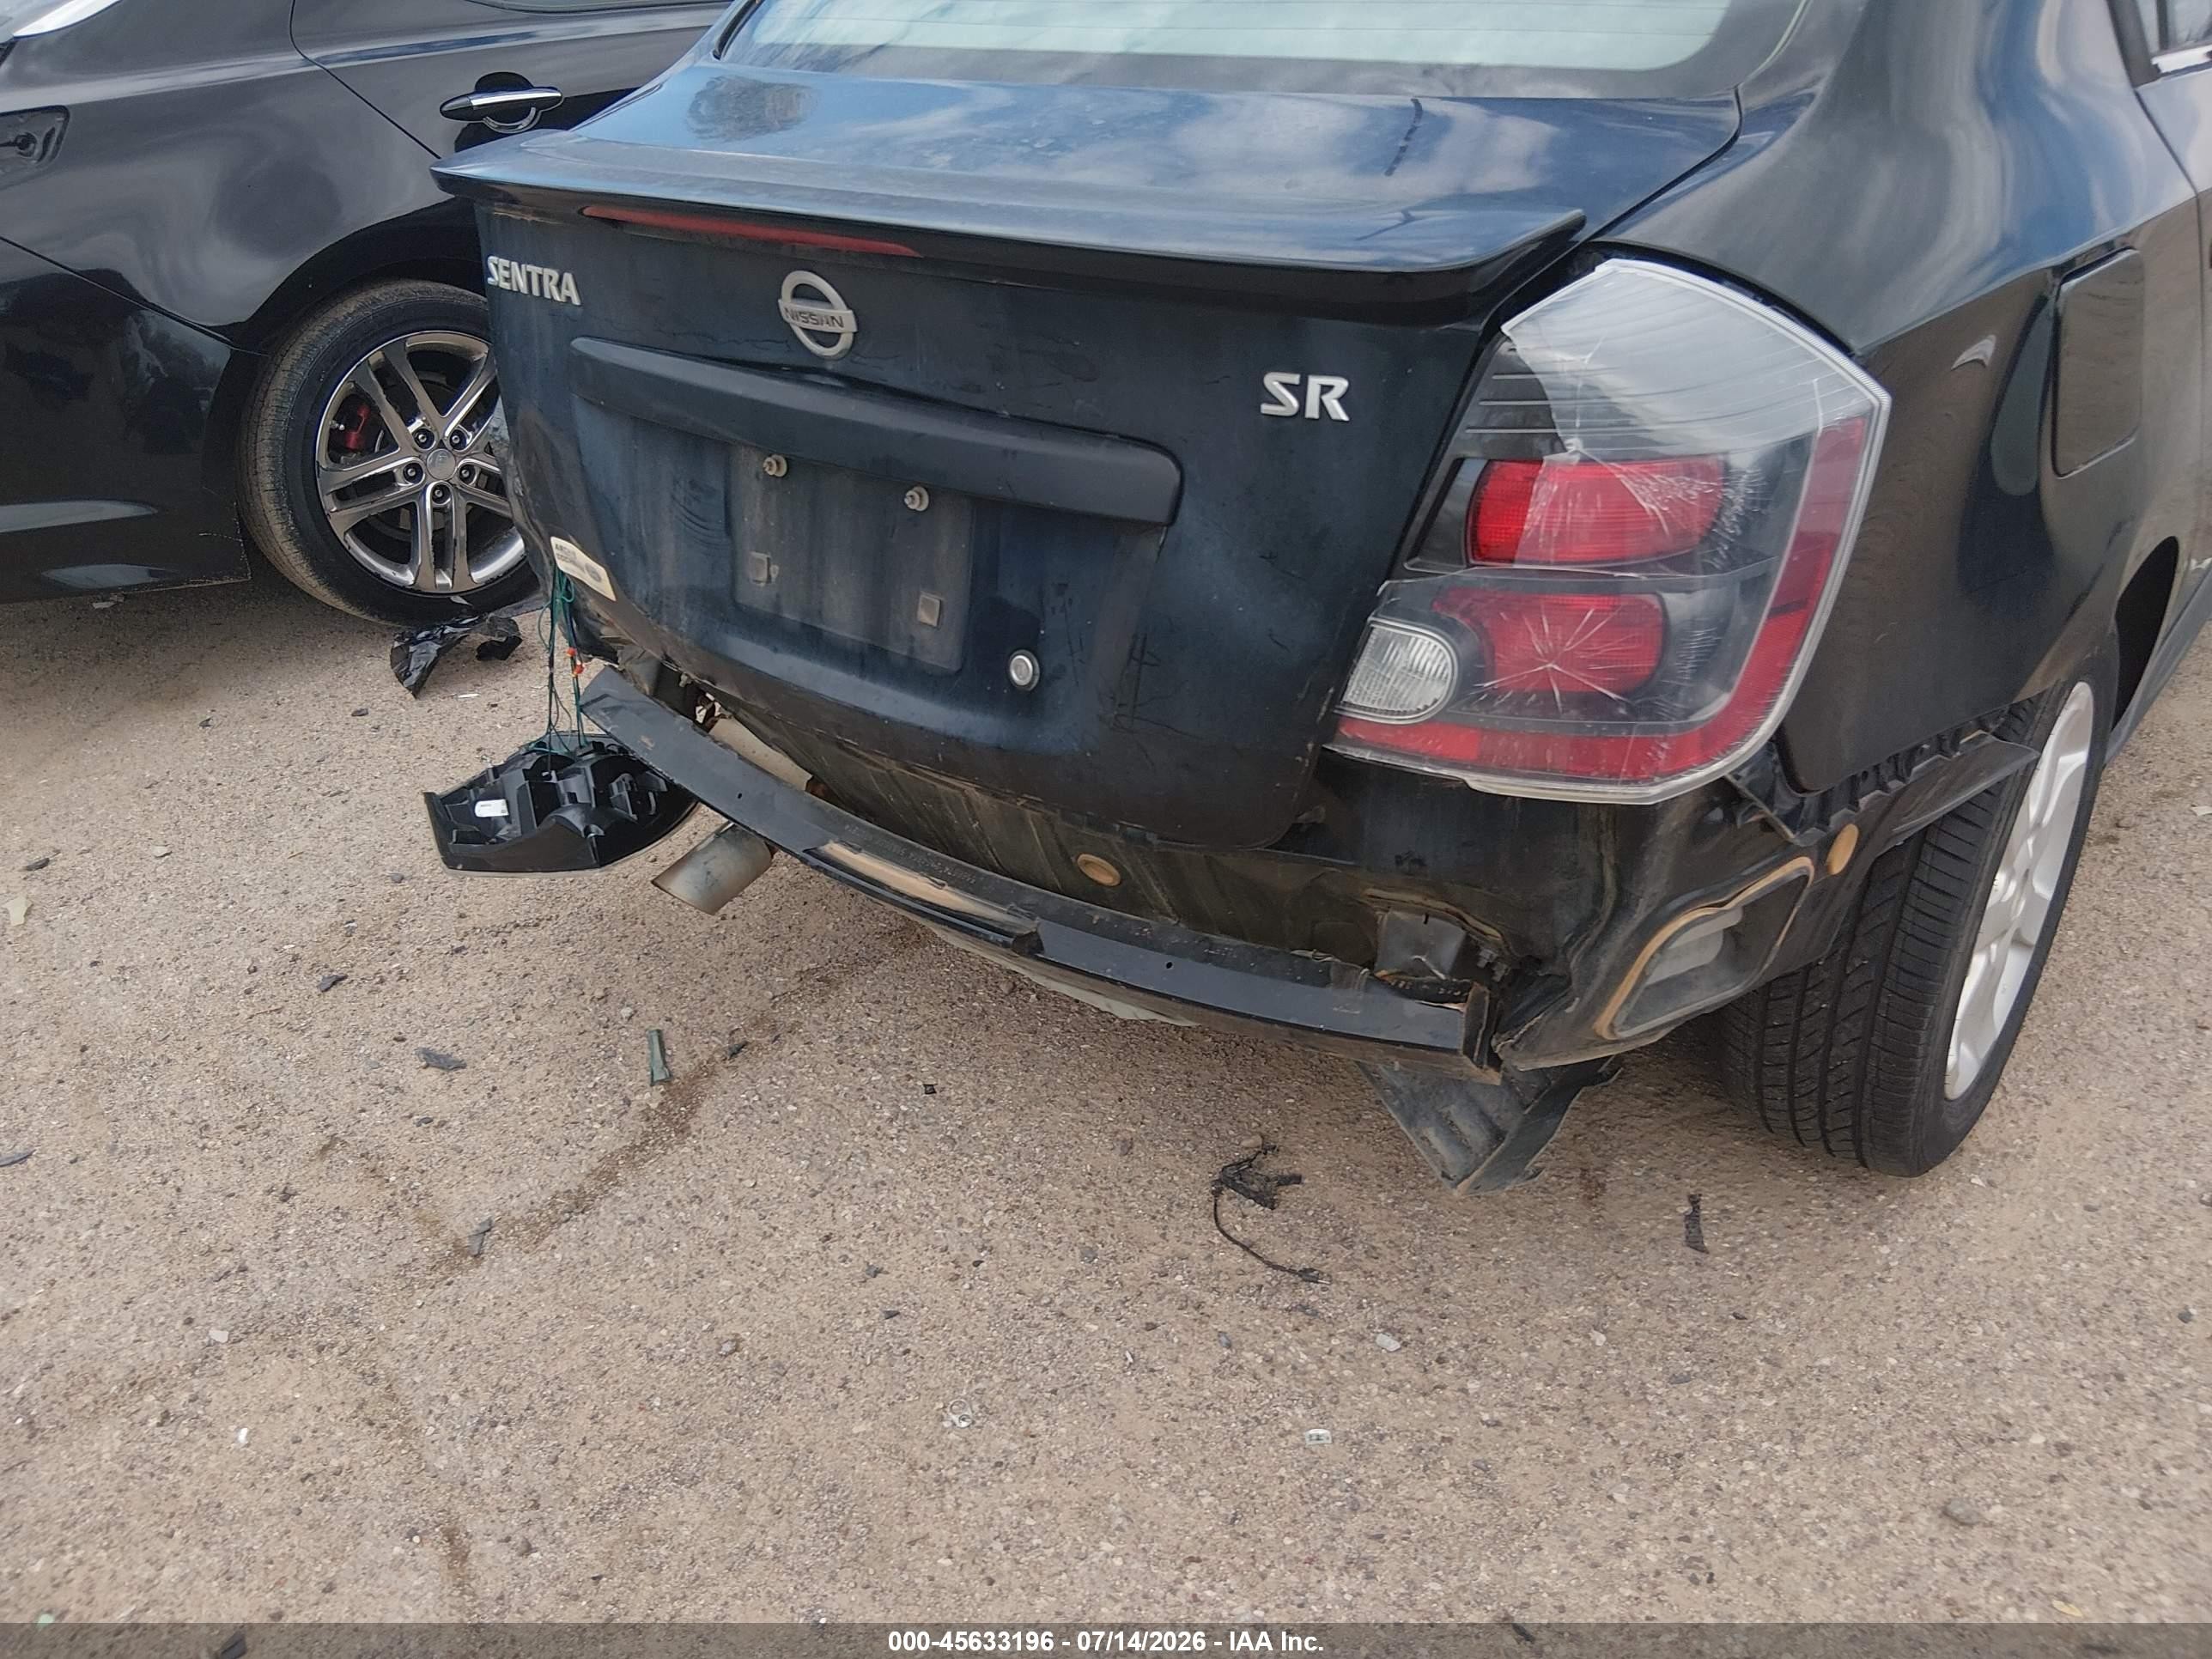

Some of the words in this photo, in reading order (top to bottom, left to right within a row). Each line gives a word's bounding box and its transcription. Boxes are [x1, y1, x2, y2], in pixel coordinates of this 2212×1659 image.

[487, 255, 581, 306] SENTRA
[783, 307, 845, 329] NISSAN
[1260, 371, 1350, 422] SR
